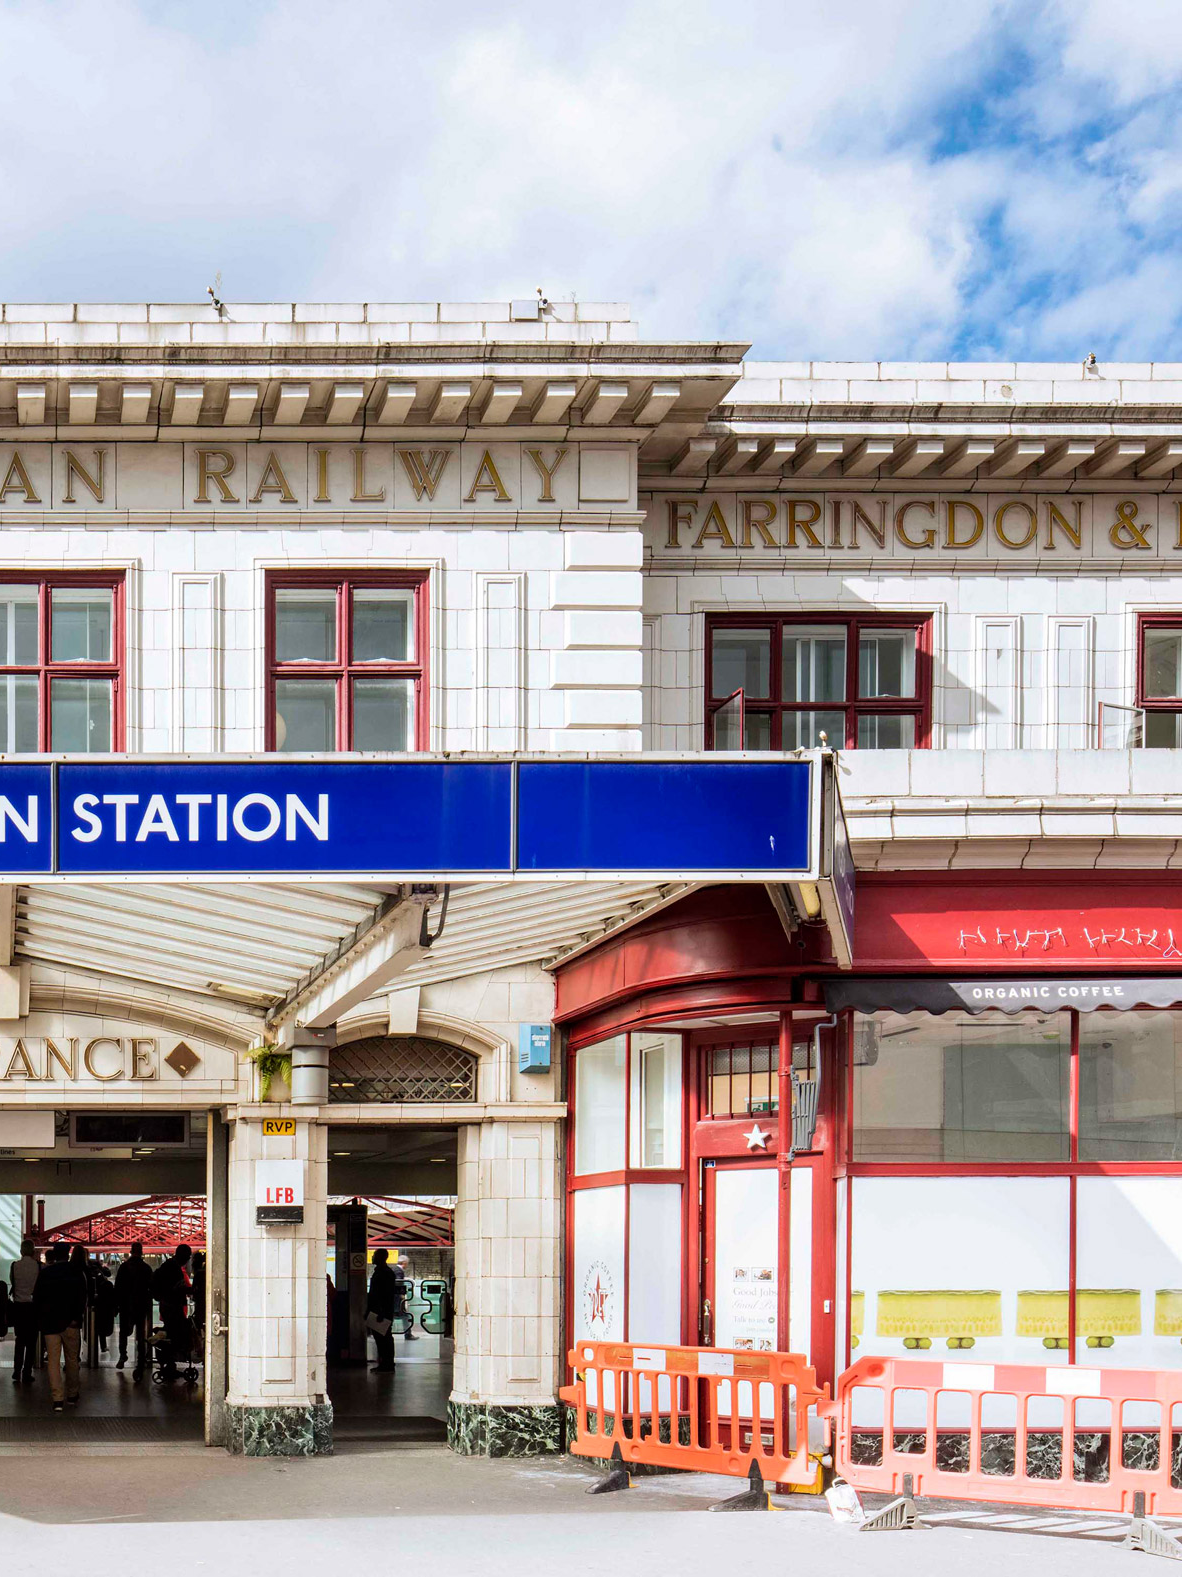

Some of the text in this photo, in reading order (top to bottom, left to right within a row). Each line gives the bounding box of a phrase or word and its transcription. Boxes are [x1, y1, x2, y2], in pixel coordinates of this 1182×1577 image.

[194, 448, 570, 502] RAILWAY
[665, 499, 1084, 550] FARRINGDON
[1108, 500, 1153, 550] &
[71, 792, 329, 843] STATION
[972, 986, 1124, 999] ORGANIC COFFEE
[266, 1122, 293, 1133] RVP
[266, 1187, 294, 1204] LFB
[733, 1287, 757, 1296] Good
